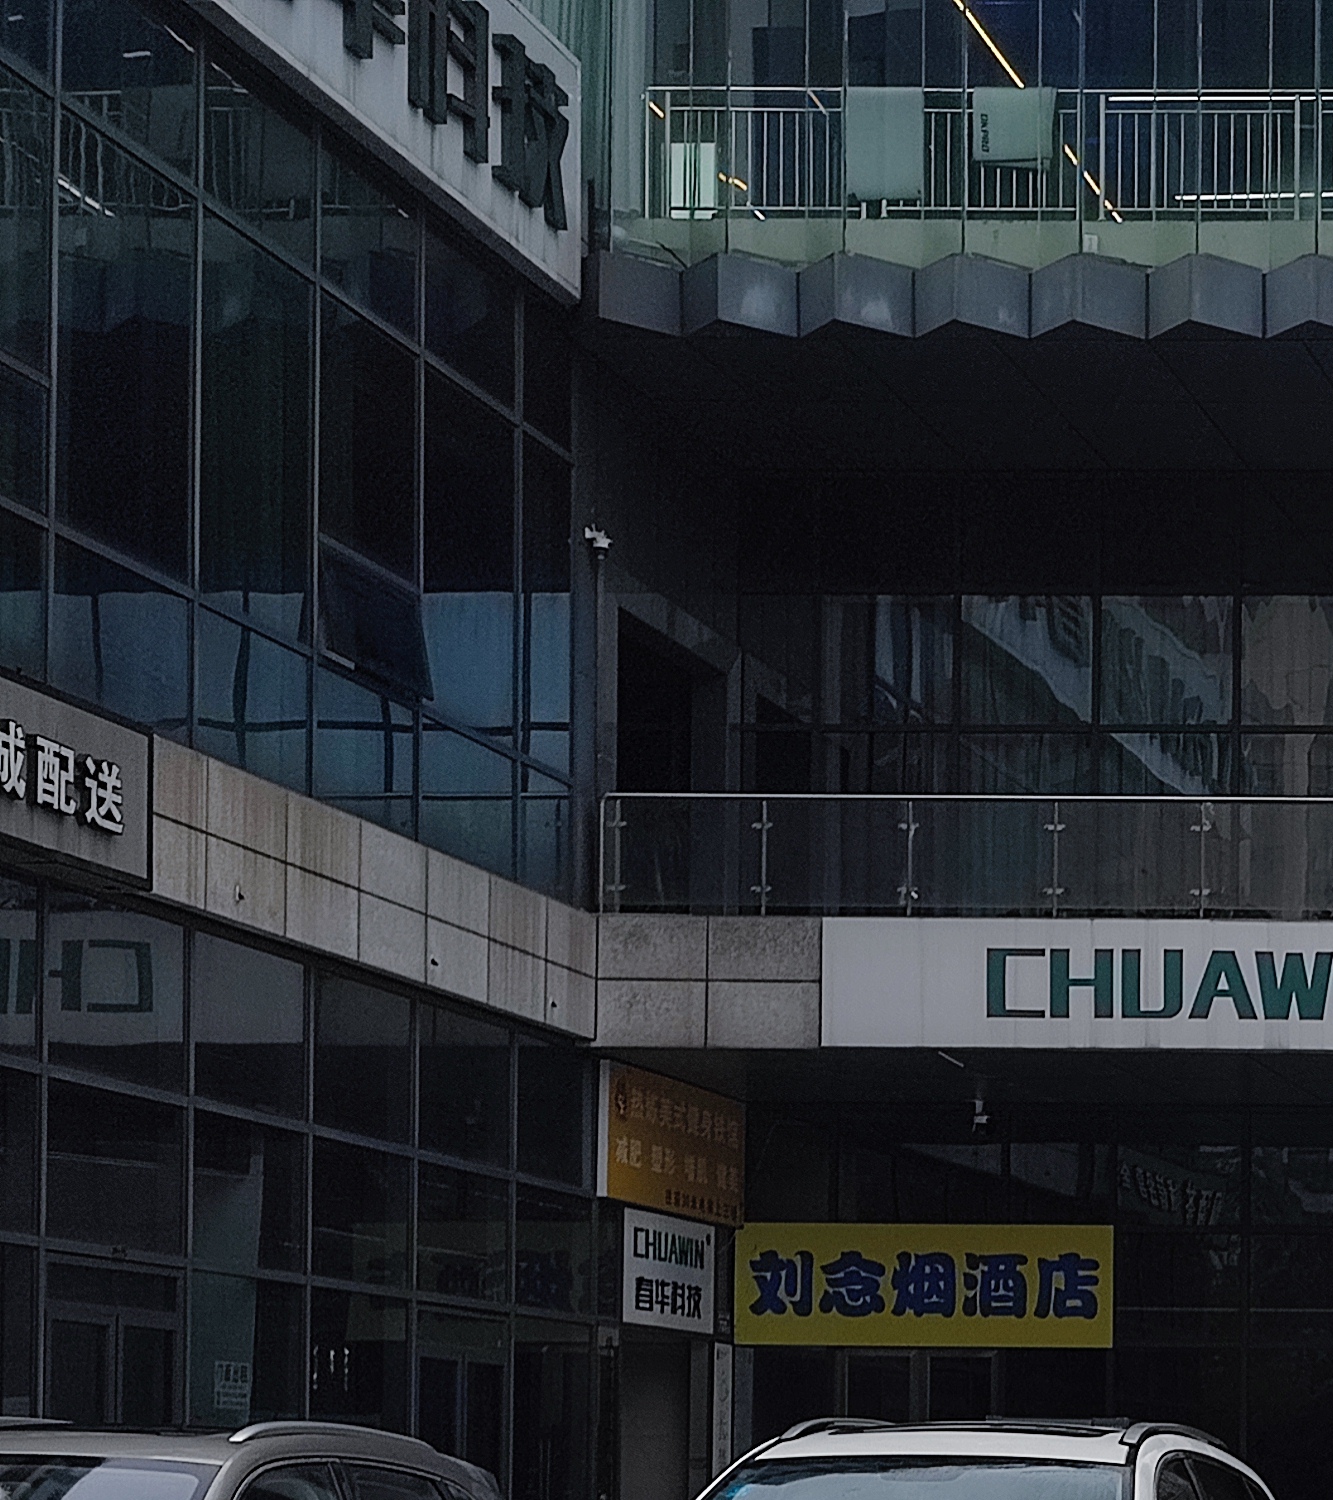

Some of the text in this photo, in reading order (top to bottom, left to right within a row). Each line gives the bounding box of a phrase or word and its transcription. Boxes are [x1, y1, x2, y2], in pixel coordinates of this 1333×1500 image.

[342, 0, 570, 230] 科技
[633, 1226, 705, 1269] CHUAWIN
[634, 1276, 702, 1319] 春华科技
[749, 1250, 1100, 1319] 刘念烟酒店
